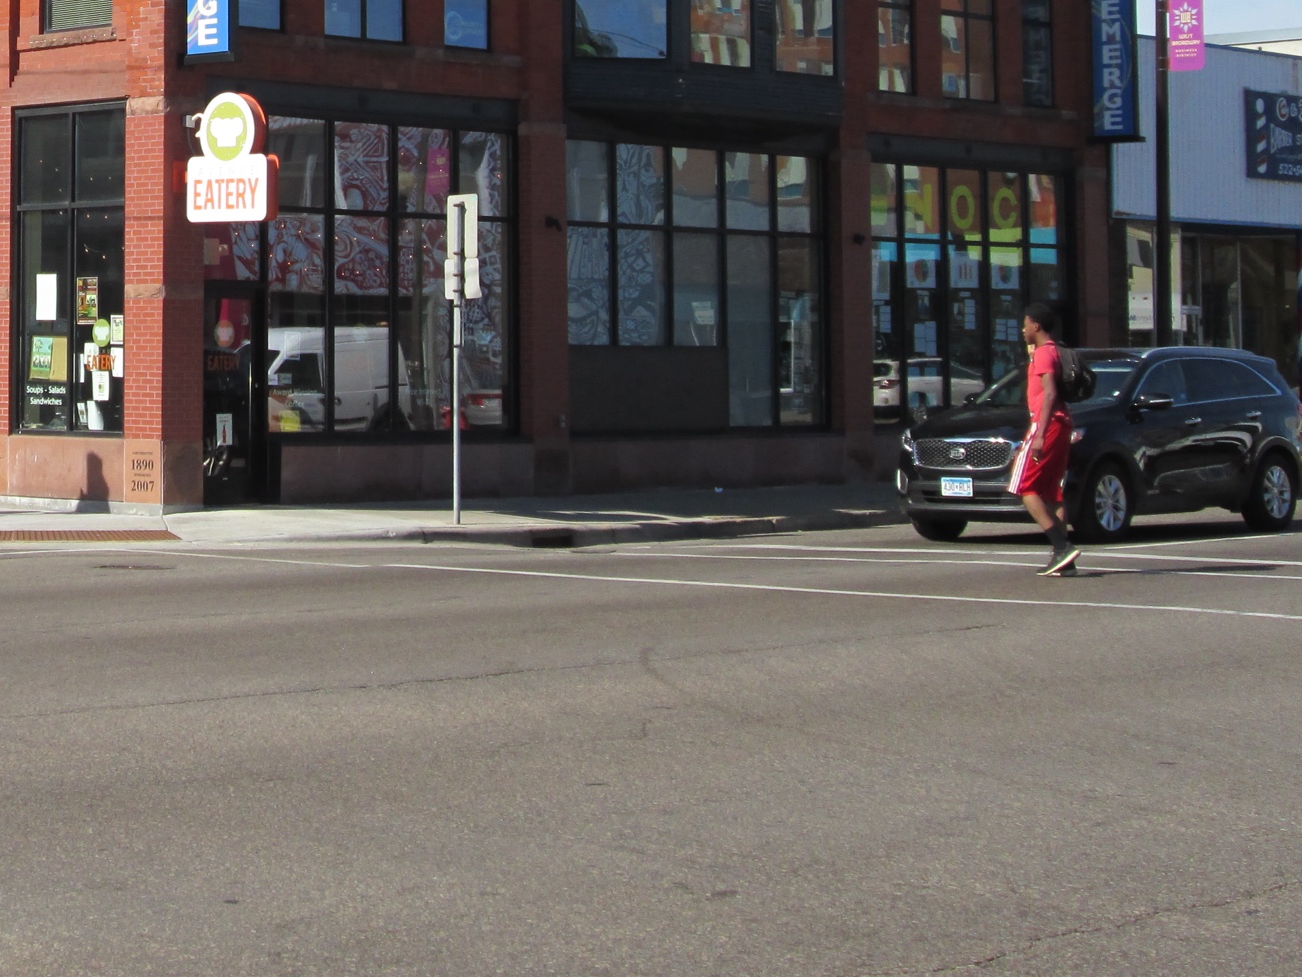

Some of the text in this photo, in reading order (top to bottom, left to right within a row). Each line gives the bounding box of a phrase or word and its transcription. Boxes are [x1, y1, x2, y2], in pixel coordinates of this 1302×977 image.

[1101, 0, 1123, 130] EMERGE
[193, 178, 259, 210] EATERY
[86, 354, 116, 371] EATERY
[207, 355, 240, 372] EATERY
[26, 385, 43, 395] Soups
[48, 385, 66, 394] Salads
[29, 396, 63, 406] Sandwiches
[131, 459, 154, 471] 1890
[131, 480, 155, 492] 2007
